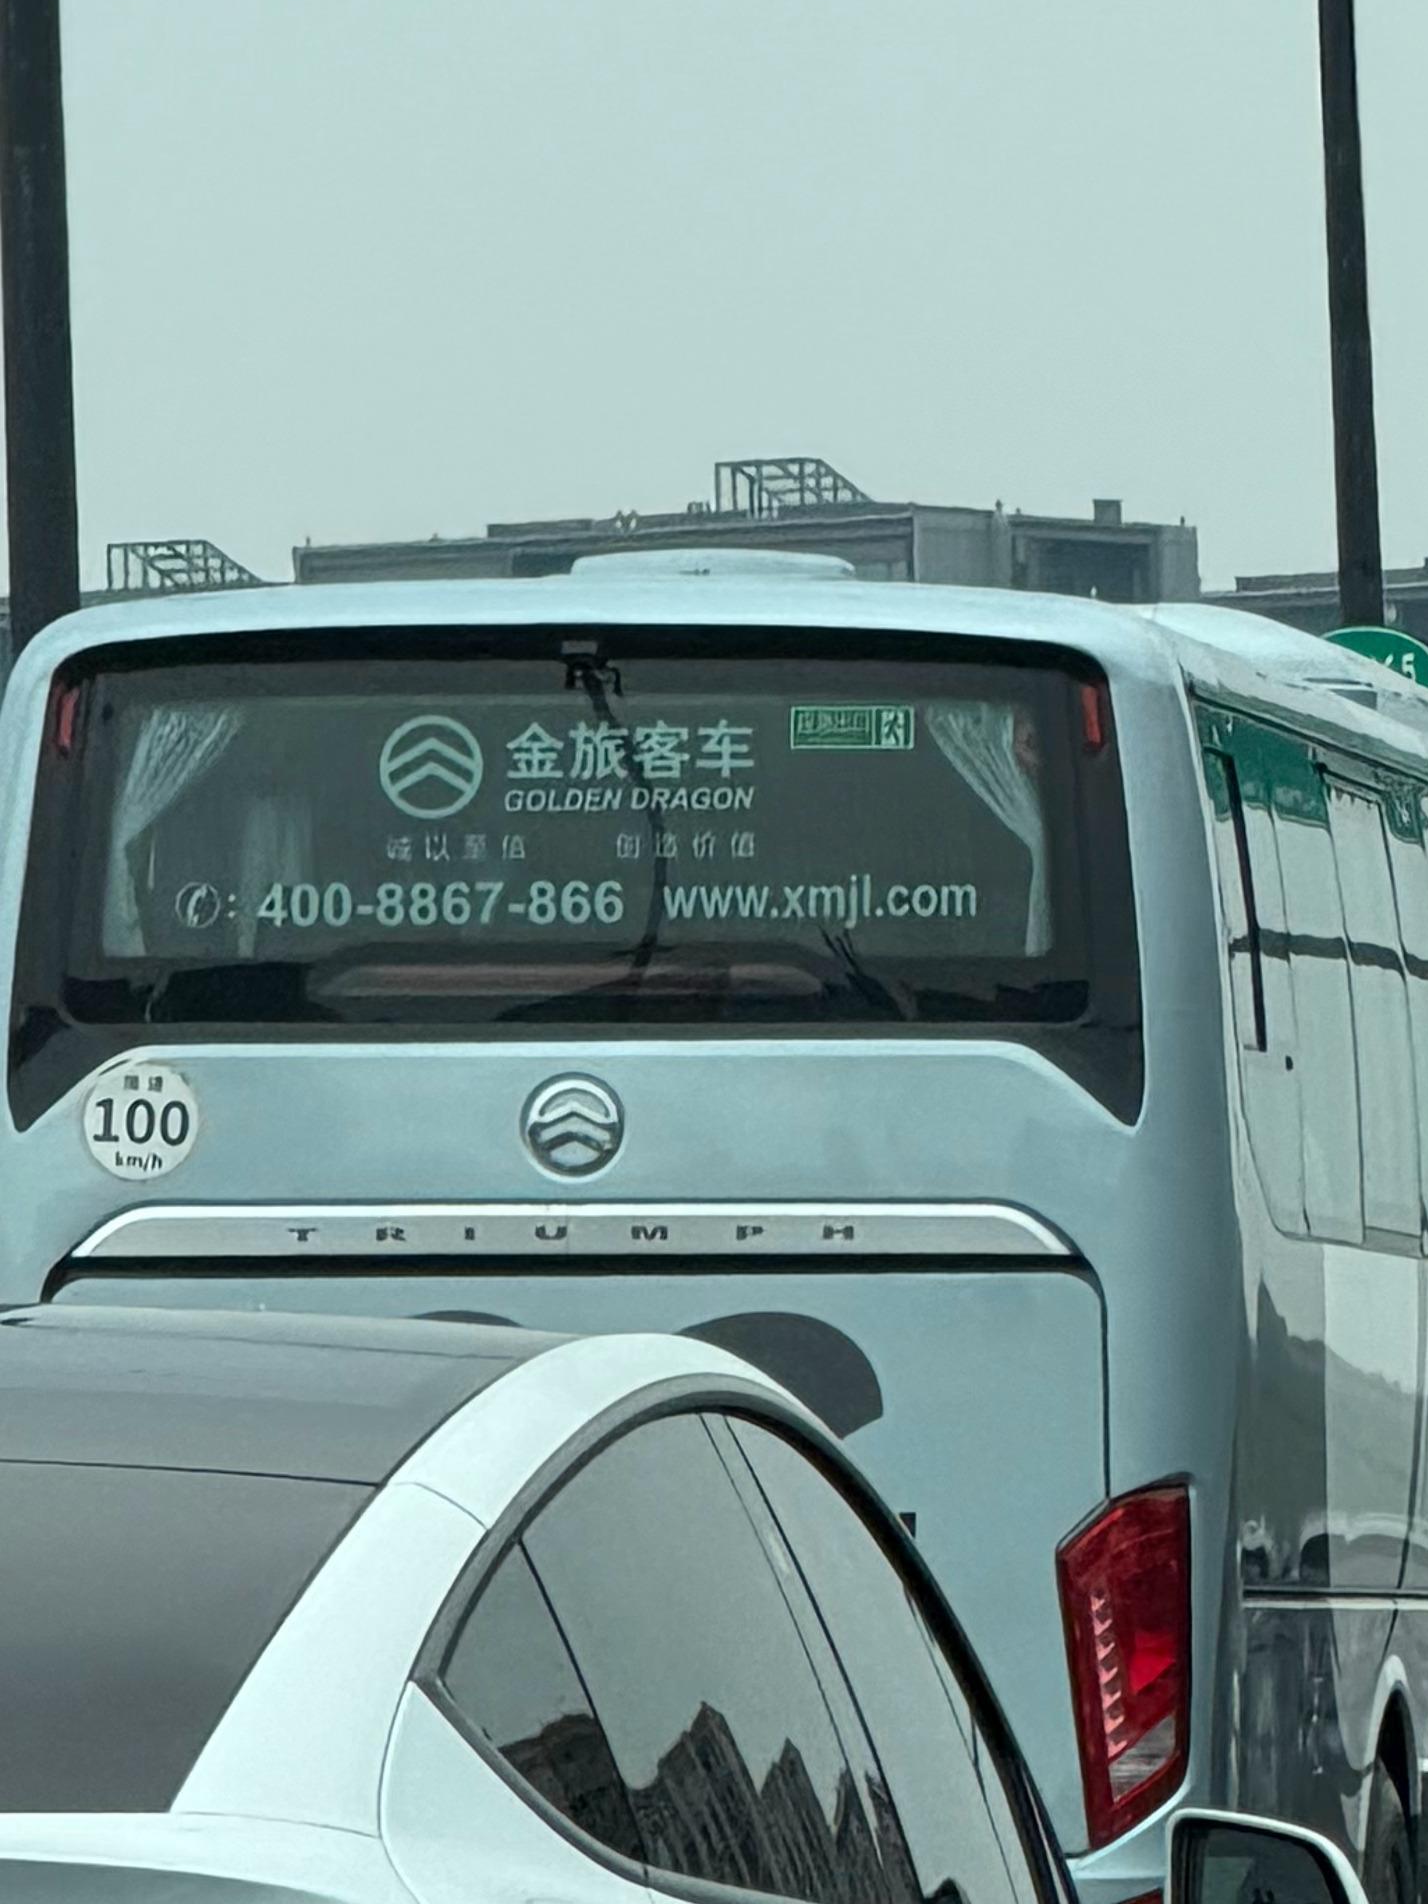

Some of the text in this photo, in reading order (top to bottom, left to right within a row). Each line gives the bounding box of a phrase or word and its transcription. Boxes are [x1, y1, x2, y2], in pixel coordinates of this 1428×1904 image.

[507, 719, 754, 780] 金旅客车
[504, 786, 755, 812] GOLDEN DRAGON
[256, 874, 976, 929] 400-8867-866 www.xmjl.com
[93, 1098, 190, 1146] 100
[115, 1151, 163, 1172] km/h
[288, 1224, 854, 1243] TRIUMPH
